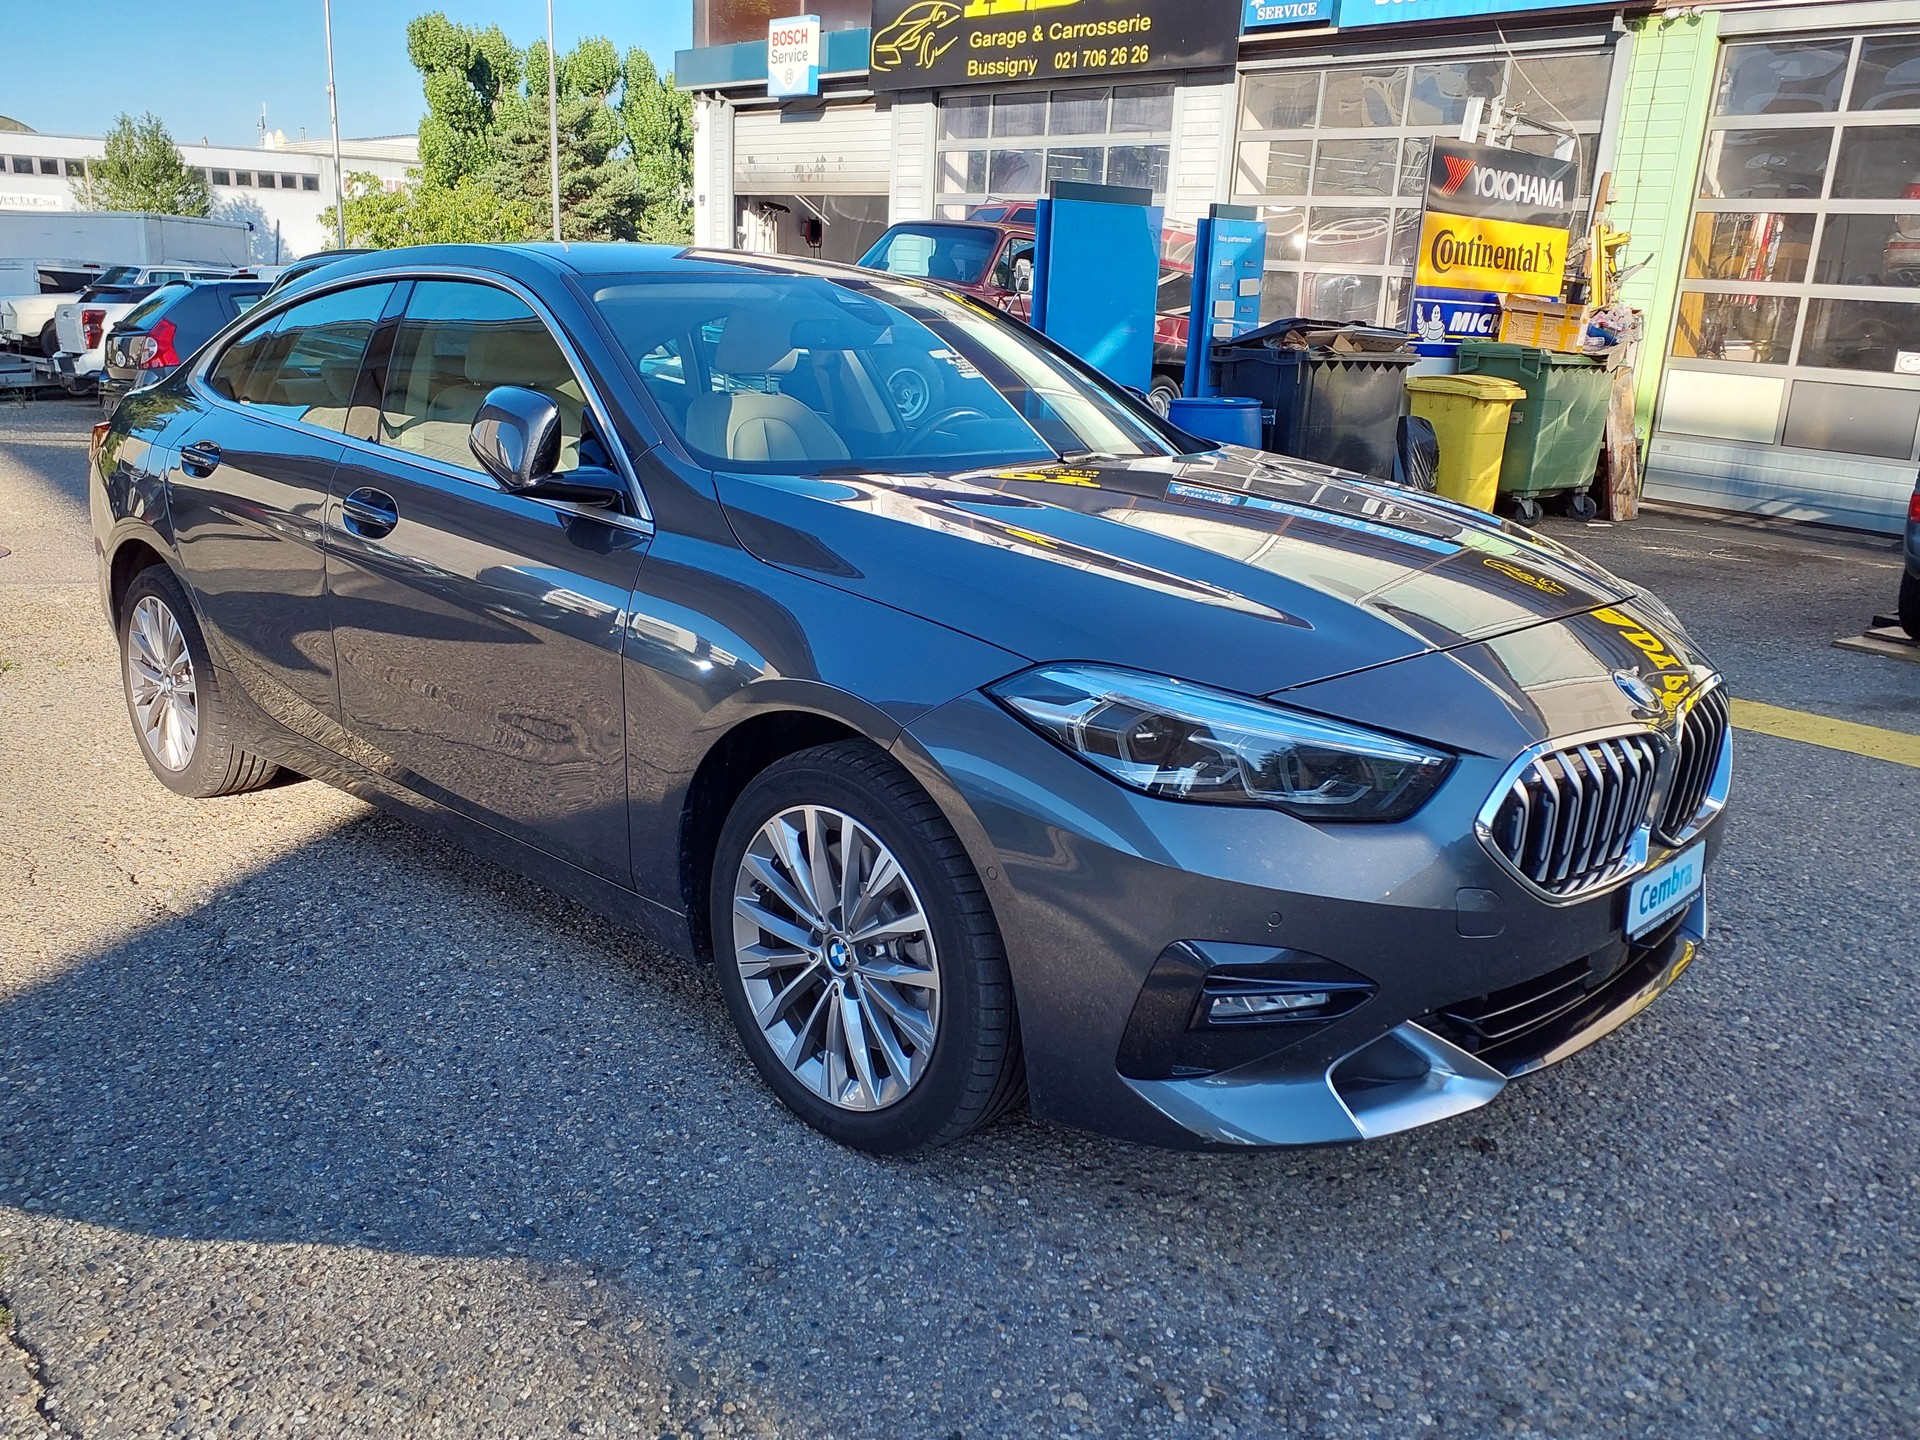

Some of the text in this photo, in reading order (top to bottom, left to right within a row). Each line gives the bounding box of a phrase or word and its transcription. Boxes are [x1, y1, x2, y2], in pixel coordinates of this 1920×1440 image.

[1257, 2, 1317, 20] SERVICE
[772, 28, 808, 46] BOSCH
[969, 13, 1151, 48] Garage & Carrosserie
[771, 48, 808, 64] Service
[967, 44, 1149, 77] Bussigny 021 706 26 26
[1474, 165, 1564, 209] YOKOHAMA
[1431, 229, 1540, 274] Continental
[1640, 863, 1693, 915] Cembra
